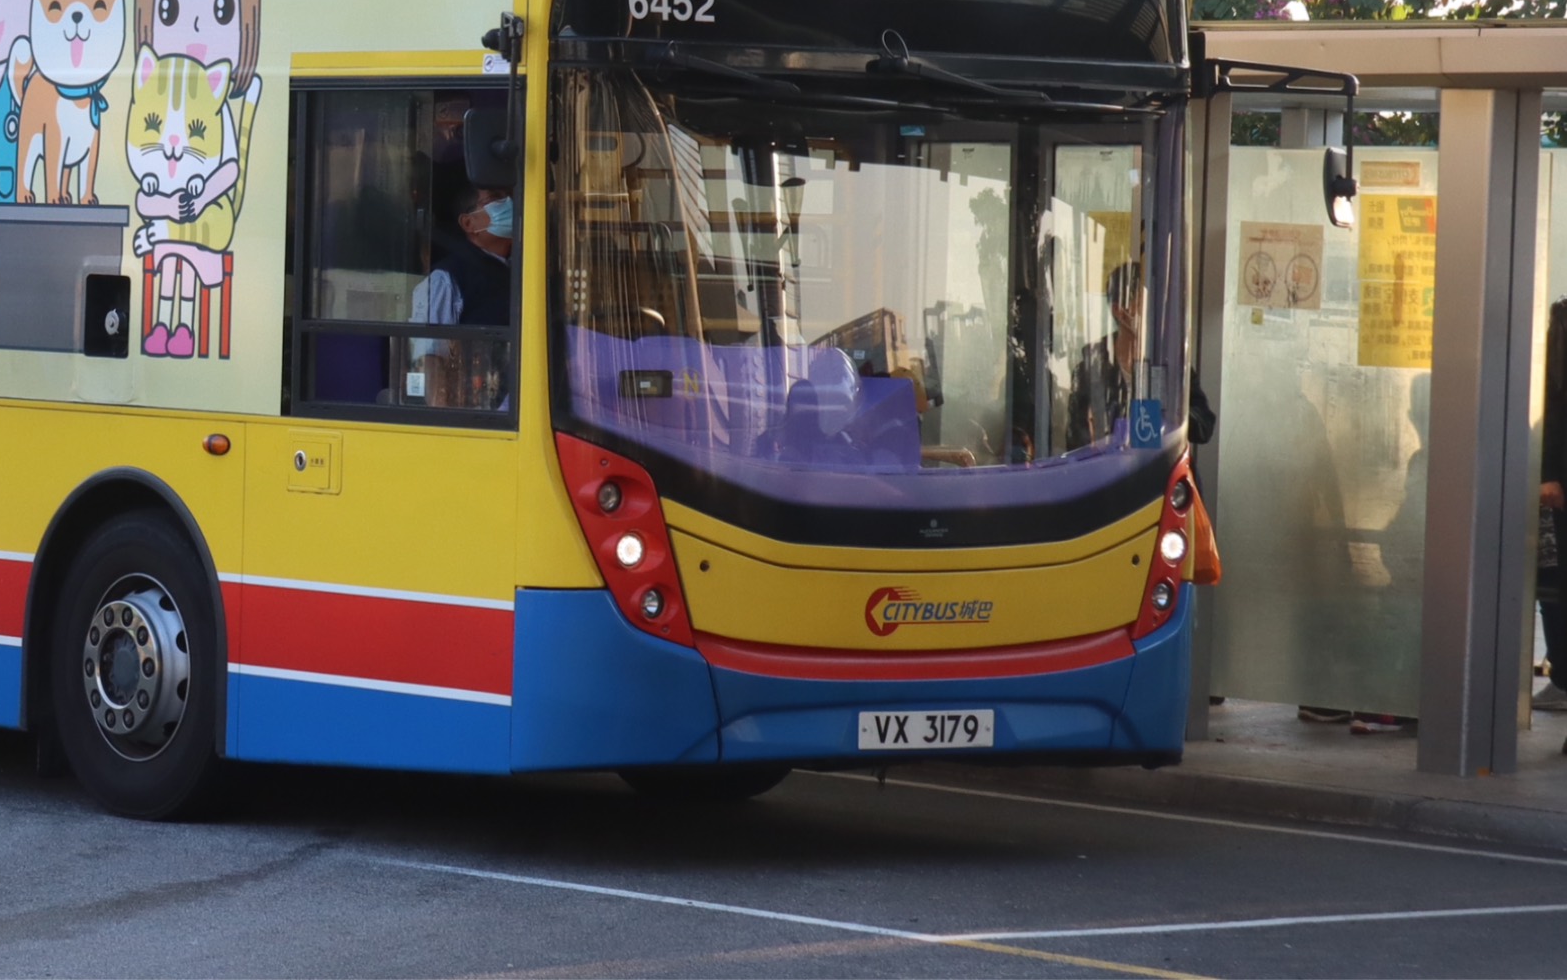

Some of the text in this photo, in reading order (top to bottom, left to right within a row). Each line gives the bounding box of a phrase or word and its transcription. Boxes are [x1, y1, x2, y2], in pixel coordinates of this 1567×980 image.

[883, 600, 993, 621] CITYBUS 城巴
[874, 714, 979, 744] VX 3179
